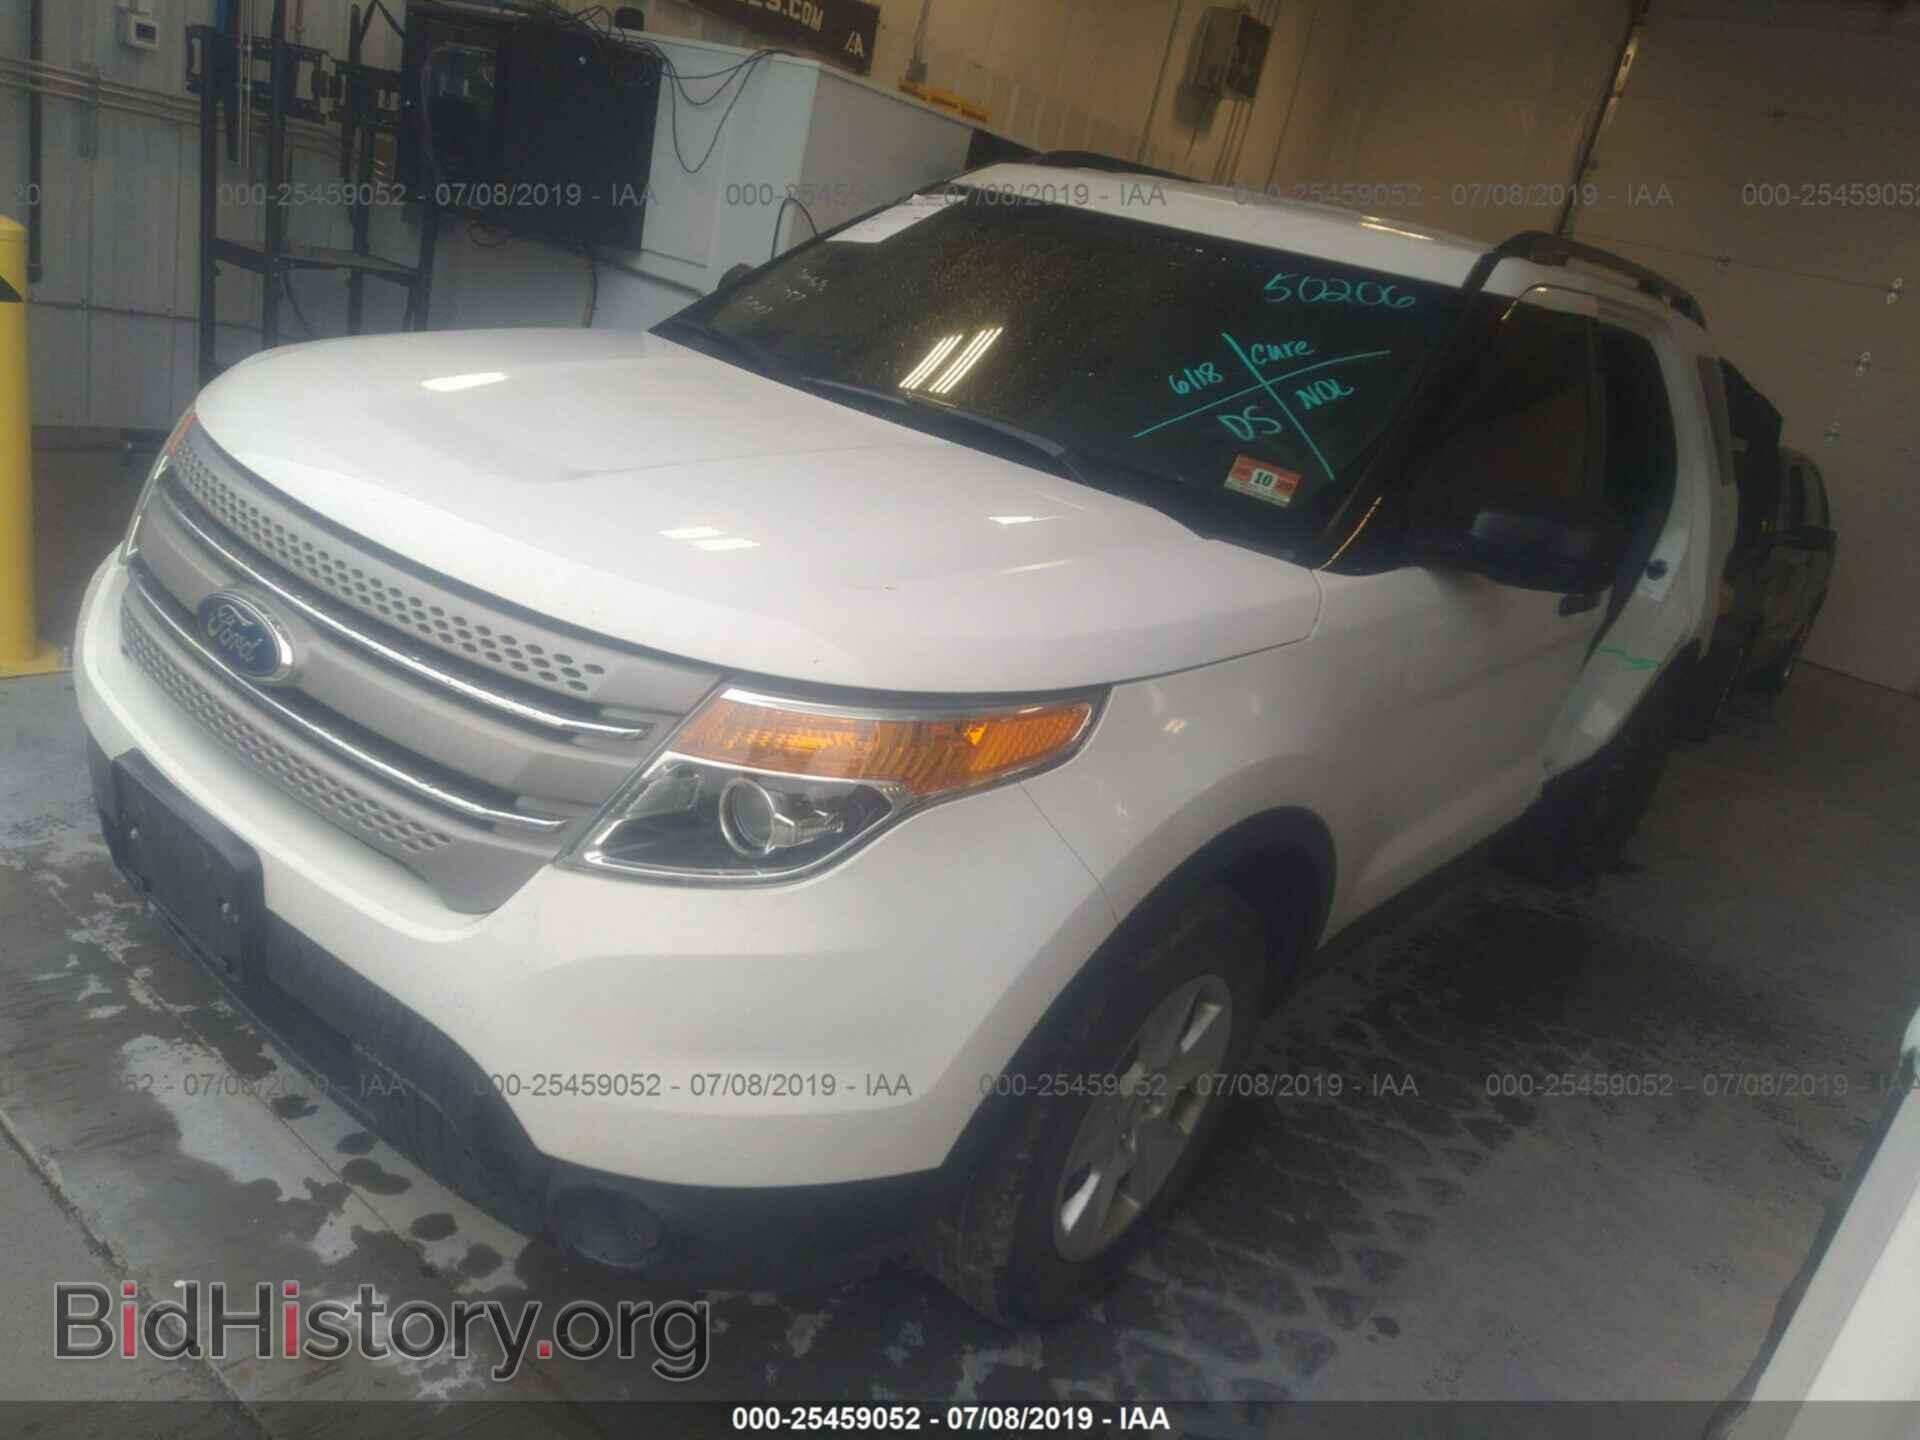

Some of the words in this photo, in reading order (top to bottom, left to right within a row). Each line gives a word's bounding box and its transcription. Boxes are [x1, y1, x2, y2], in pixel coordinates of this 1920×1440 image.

[1264, 272, 1416, 308] 50206
[1254, 471, 1273, 487] 10
[207, 603, 264, 664] Ford
